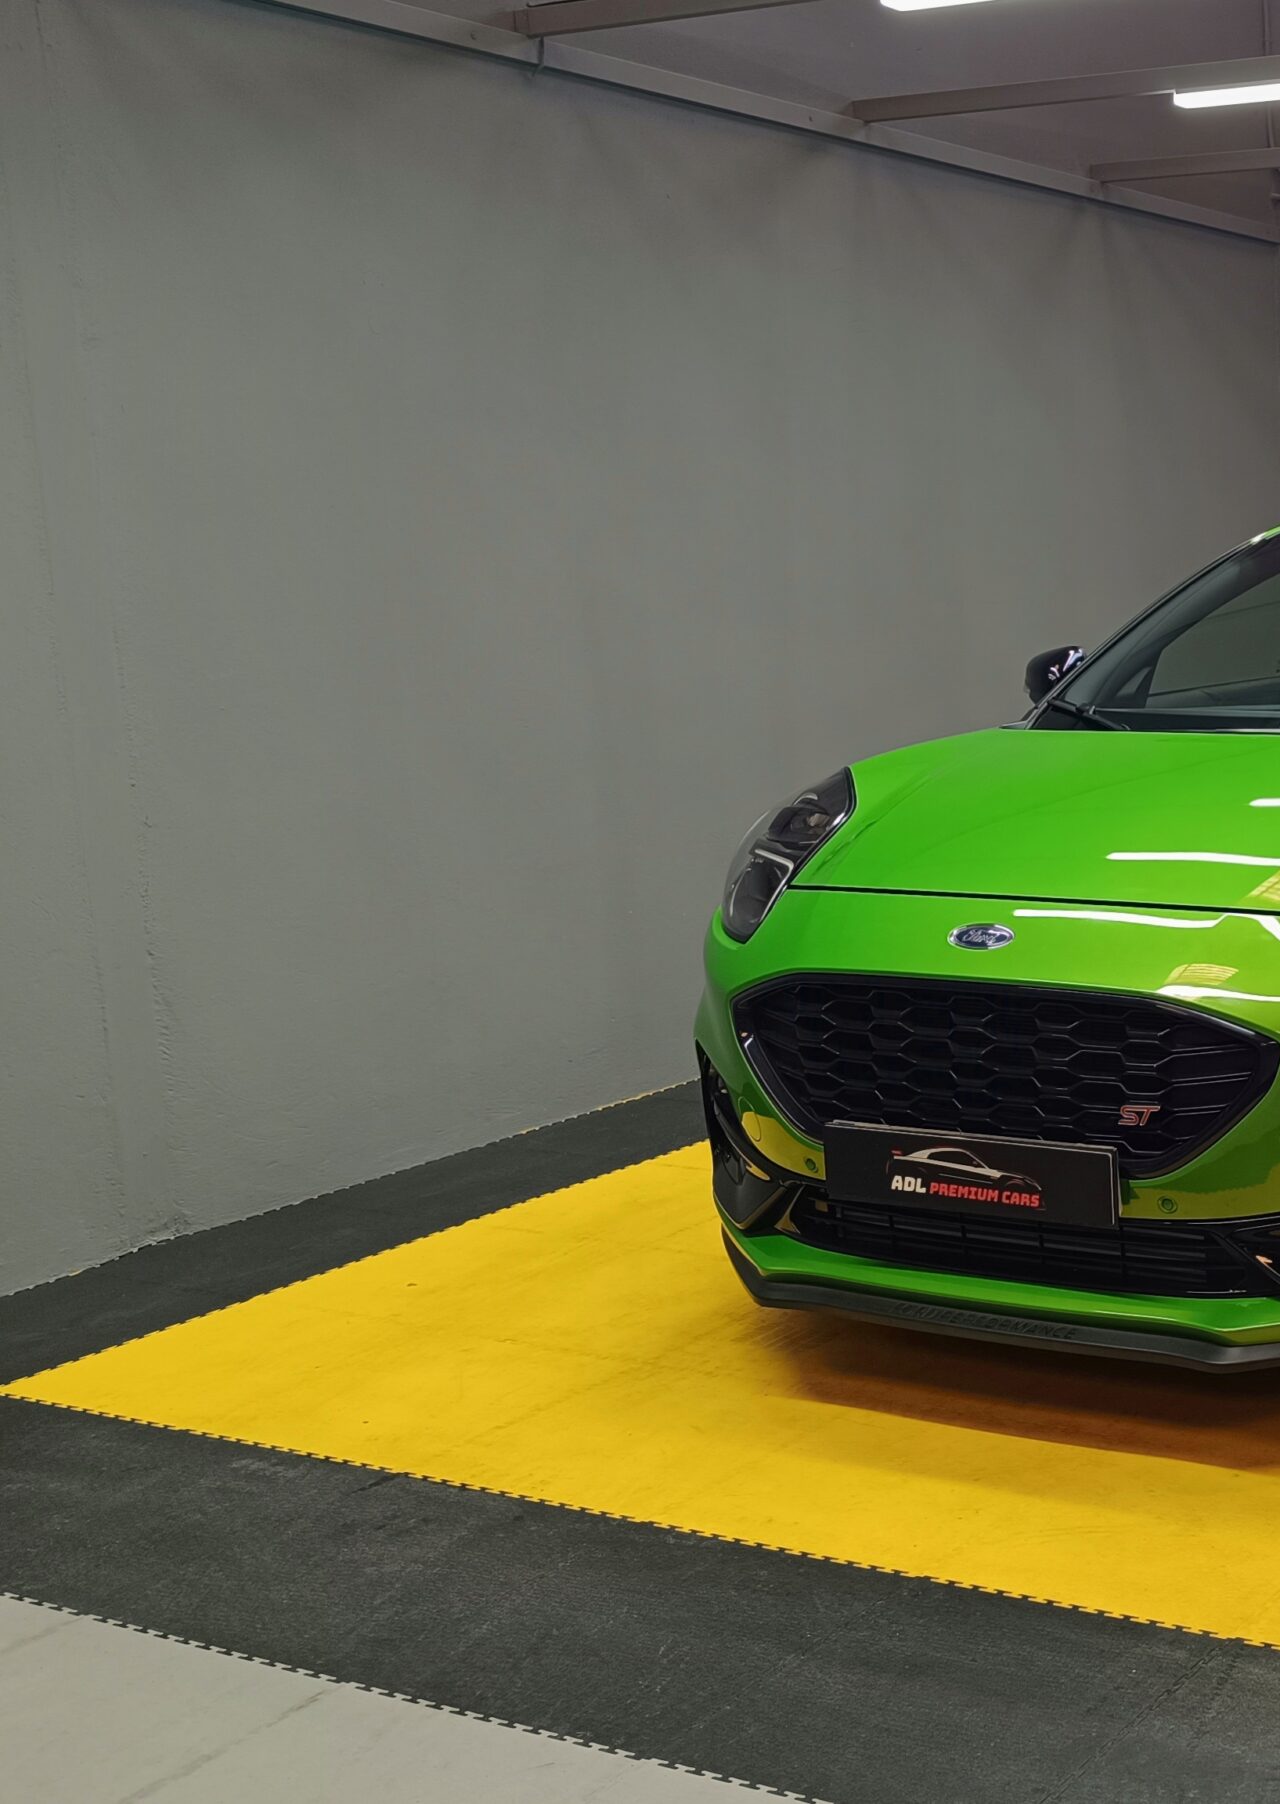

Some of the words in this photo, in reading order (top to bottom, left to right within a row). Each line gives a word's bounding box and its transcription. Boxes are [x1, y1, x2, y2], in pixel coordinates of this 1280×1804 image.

[1118, 1105, 1160, 1126] ST
[891, 1175, 926, 1193] ADL
[929, 1182, 999, 1202] PREMIUM
[1001, 1191, 1040, 1207] CARS
